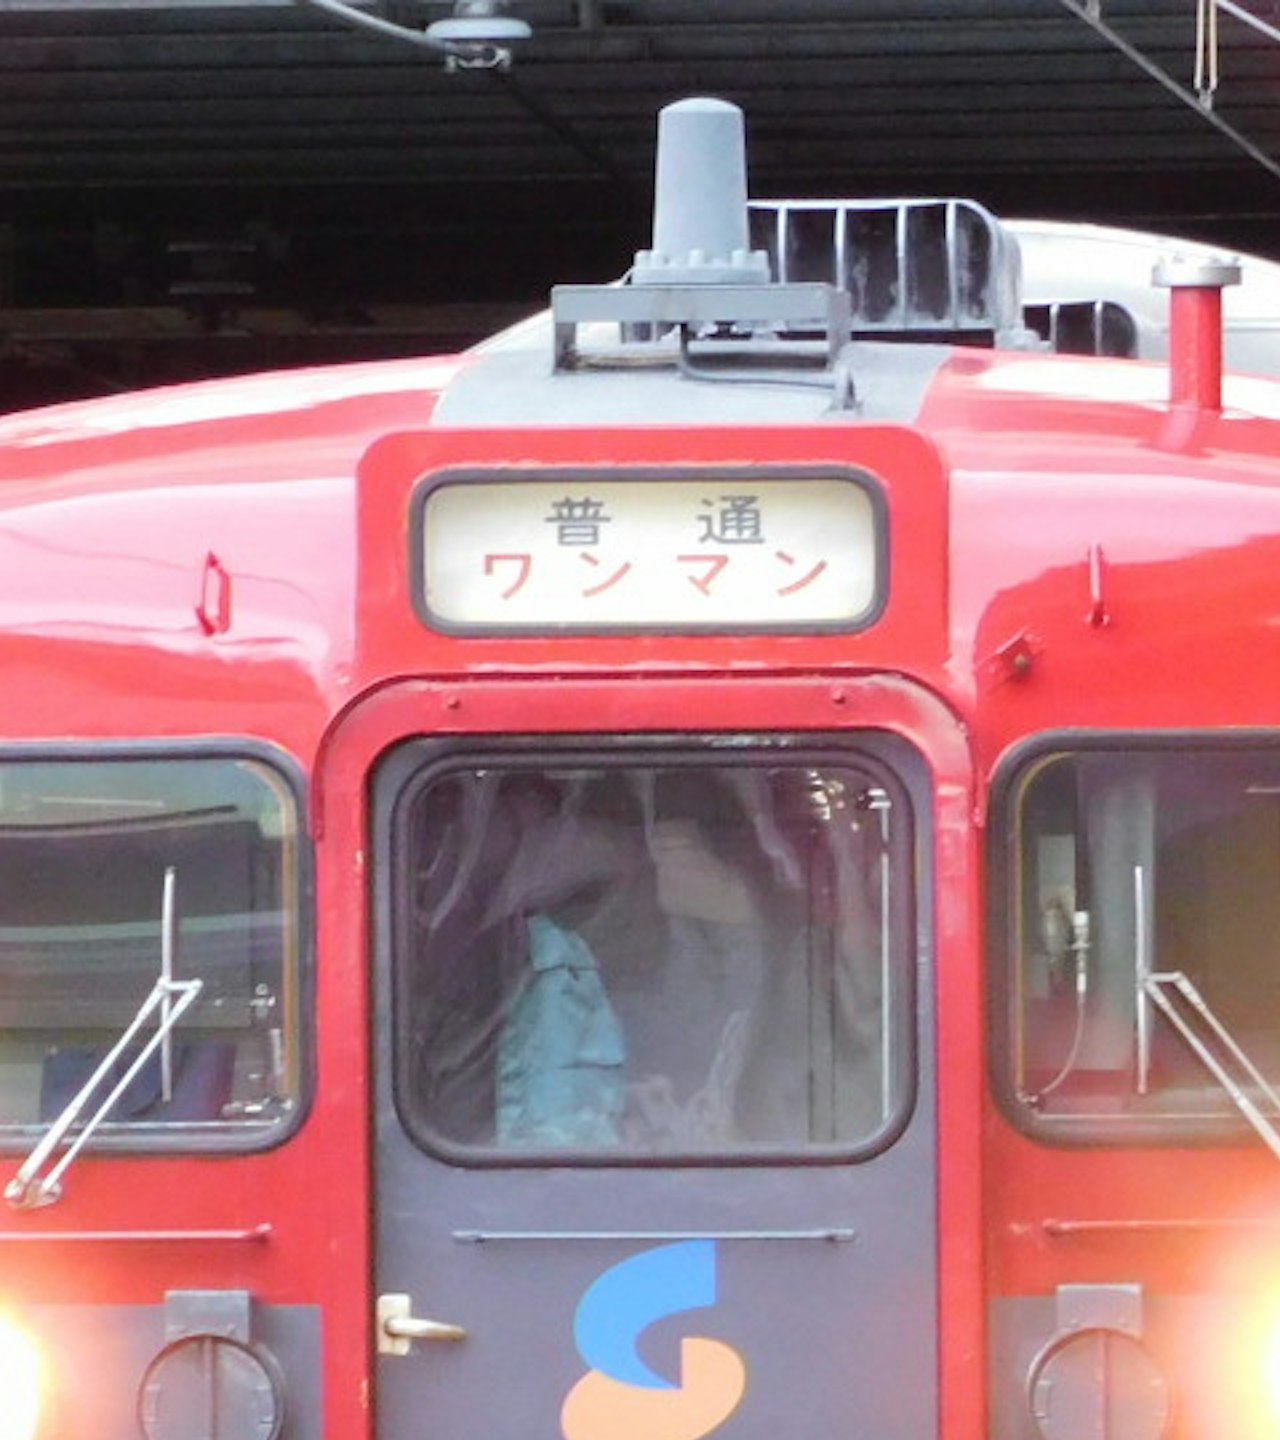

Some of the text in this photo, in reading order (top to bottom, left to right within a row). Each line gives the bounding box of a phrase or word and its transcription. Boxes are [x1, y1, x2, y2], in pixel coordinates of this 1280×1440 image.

[544, 495, 765, 546] 普通
[483, 552, 828, 600] ワンマン
